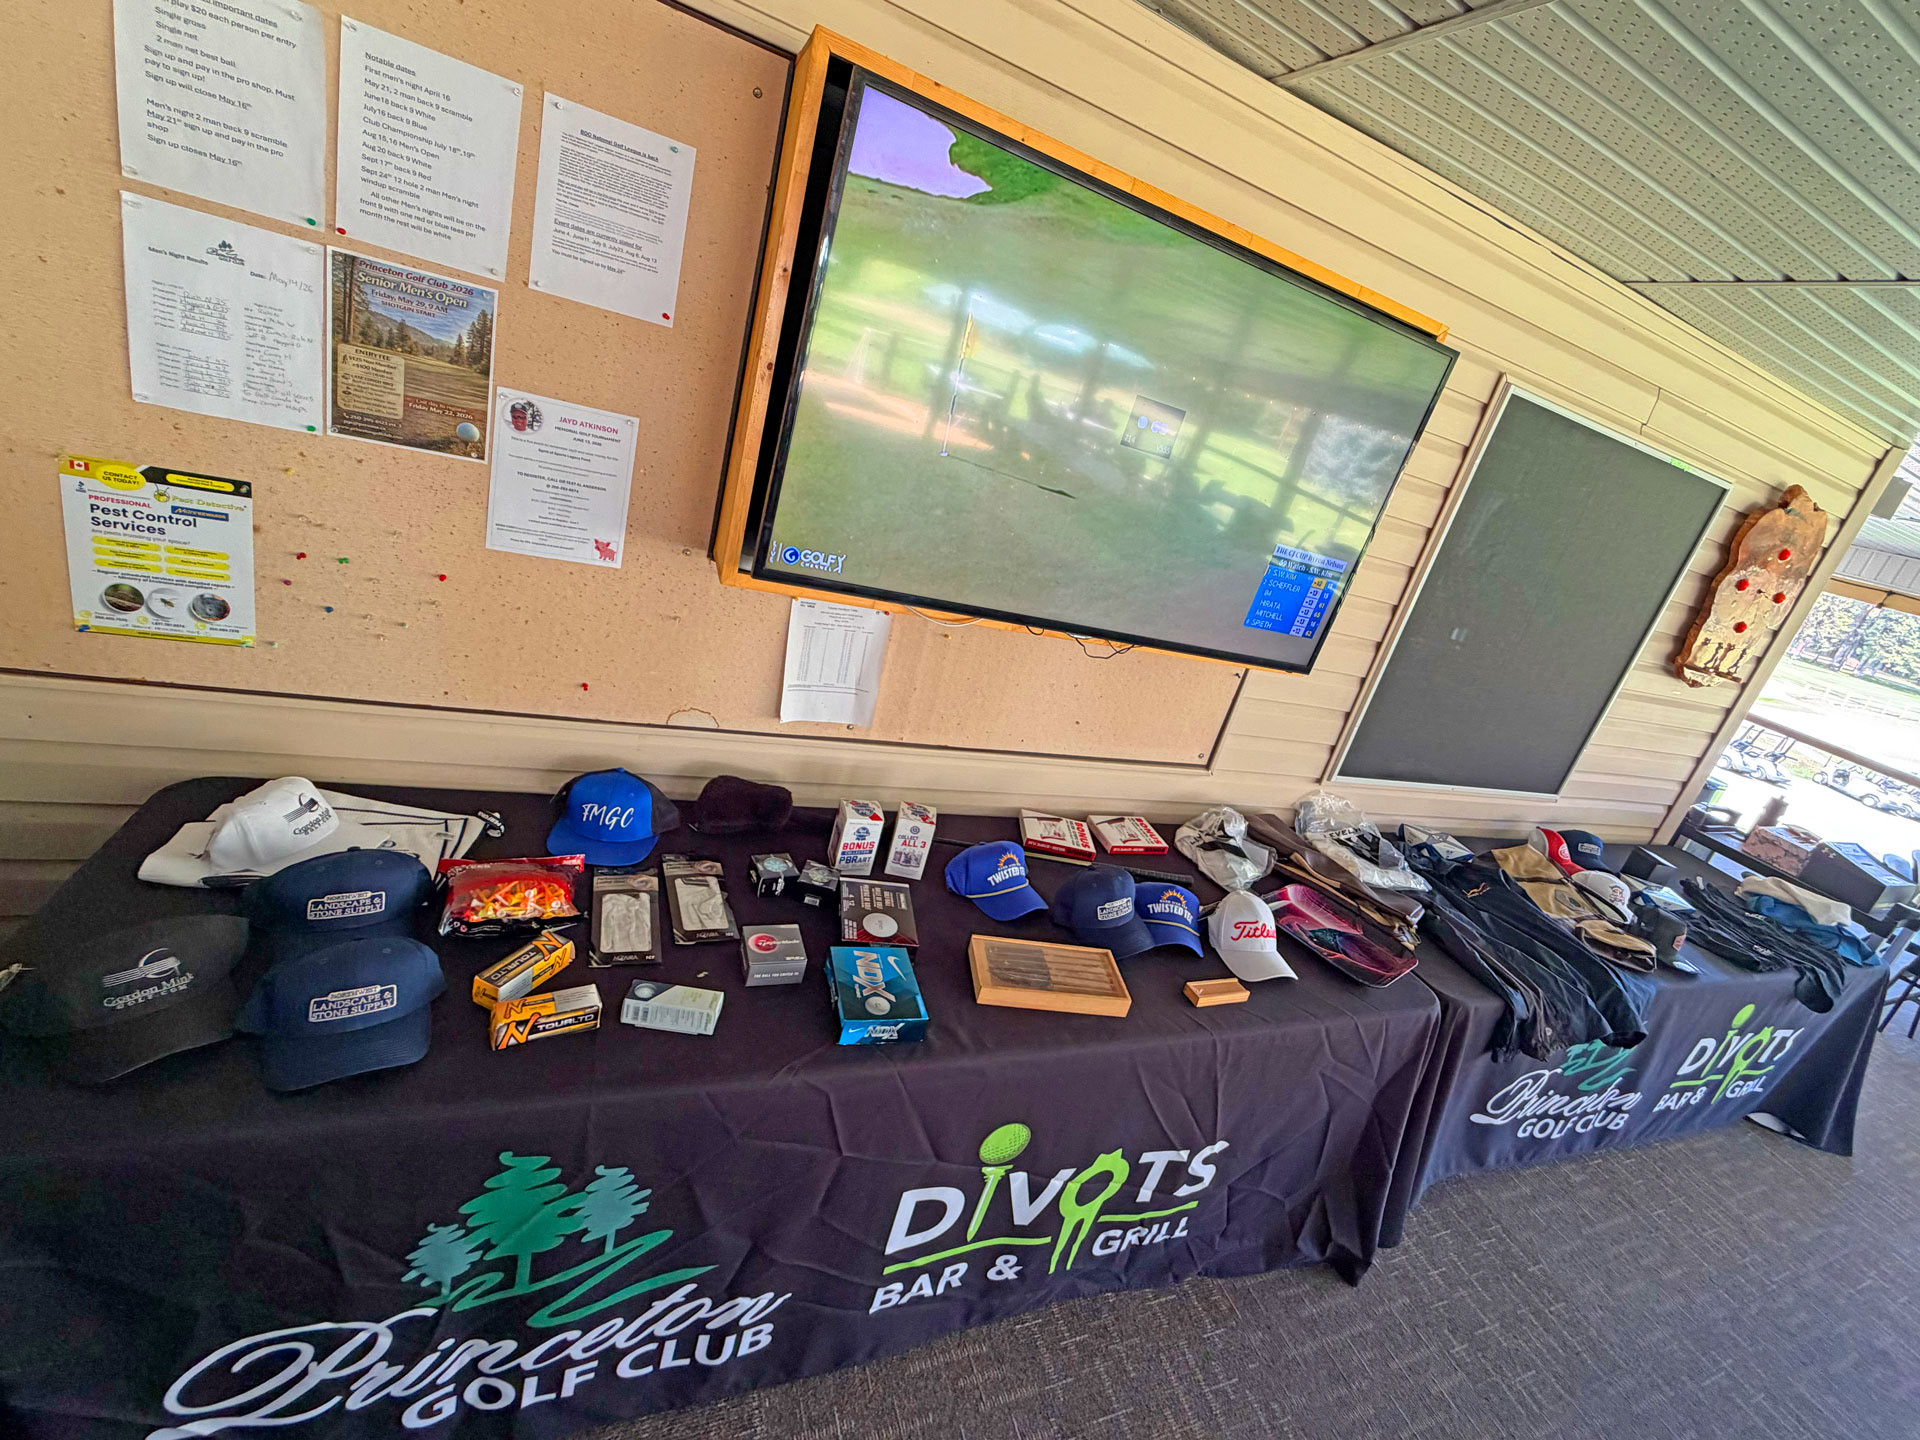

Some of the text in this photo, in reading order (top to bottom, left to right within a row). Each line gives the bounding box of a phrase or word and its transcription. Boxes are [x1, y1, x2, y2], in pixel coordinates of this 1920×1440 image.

[155, 6, 182, 21] Single
[254, 14, 278, 28] dates
[191, 4, 207, 16] $20
[208, 12, 229, 24] each
[231, 20, 260, 35] person
[261, 31, 275, 41] per
[276, 35, 297, 49] entry
[144, 44, 163, 56] Sign
[164, 53, 176, 61] up
[177, 58, 194, 67] and
[195, 63, 211, 74] pay
[221, 71, 235, 81] the
[236, 77, 250, 86] pro
[251, 81, 274, 95] shop.
[276, 88, 296, 101] Must
[365, 52, 416, 76] Notable dates
[365, 65, 381, 76] First
[382, 72, 404, 85] men's
[405, 80, 423, 92] night
[424, 88, 441, 98] April
[364, 78, 380, 89] May
[399, 92, 416, 102] man
[417, 97, 435, 108] back
[441, 106, 473, 122] scramble
[146, 98, 172, 112] Men's
[173, 107, 195, 119] night
[202, 116, 221, 127] man
[223, 122, 243, 135] back
[251, 132, 288, 148] scramble
[363, 116, 381, 127] Club
[382, 122, 433, 146] Championship
[434, 141, 447, 151] July
[147, 133, 167, 146] Sign
[209, 152, 226, 164] May
[362, 129, 377, 140] Aug
[399, 141, 419, 153] Men's
[420, 148, 440, 160] Open
[554, 218, 570, 229] Event
[596, 232, 618, 243] currently
[358, 271, 467, 308] Senior Men's Open
[359, 260, 474, 296] Princeton Golf Club 2026
[371, 289, 397, 302] Friday,
[398, 296, 414, 306] May
[434, 305, 448, 314] AM
[381, 300, 437, 318] SHOTGUN START
[559, 416, 619, 434] JAYD ATKINSON
[103, 470, 138, 480] CONTACT
[113, 476, 140, 485] TODAY!
[88, 494, 152, 509] PROFESSIONAL
[90, 503, 197, 528] Pest Control
[91, 516, 166, 536] Services
[1268, 579, 1301, 593] SCHEFFLER
[1255, 609, 1283, 621] MITCHELL
[1260, 600, 1281, 610] HIRATA
[582, 803, 635, 830] FMGC
[1074, 821, 1091, 849] BONUS
[1135, 818, 1162, 845] BONUS
[842, 841, 876, 851] BONUS
[901, 839, 927, 849] ALL 3
[987, 866, 1020, 886] TWISTED
[310, 903, 382, 918] STONE SUPPLY
[311, 898, 372, 911] LANDSCAPE
[1147, 903, 1184, 916] TWISTED
[1230, 920, 1277, 941] Titlei
[852, 950, 897, 1003] NDX
[311, 998, 392, 1020] STONE SUPPLY
[313, 991, 392, 1012] LANDSCAPE &
[1652, 1091, 1693, 1113] BAR
[1517, 1116, 1579, 1140] GOLF
[883, 1138, 1231, 1258] DIVOTS
[868, 1216, 1189, 1315] BAR & GRILL
[143, 1283, 793, 1440] Princeton
[400, 1322, 776, 1429] GOLF CLUB
